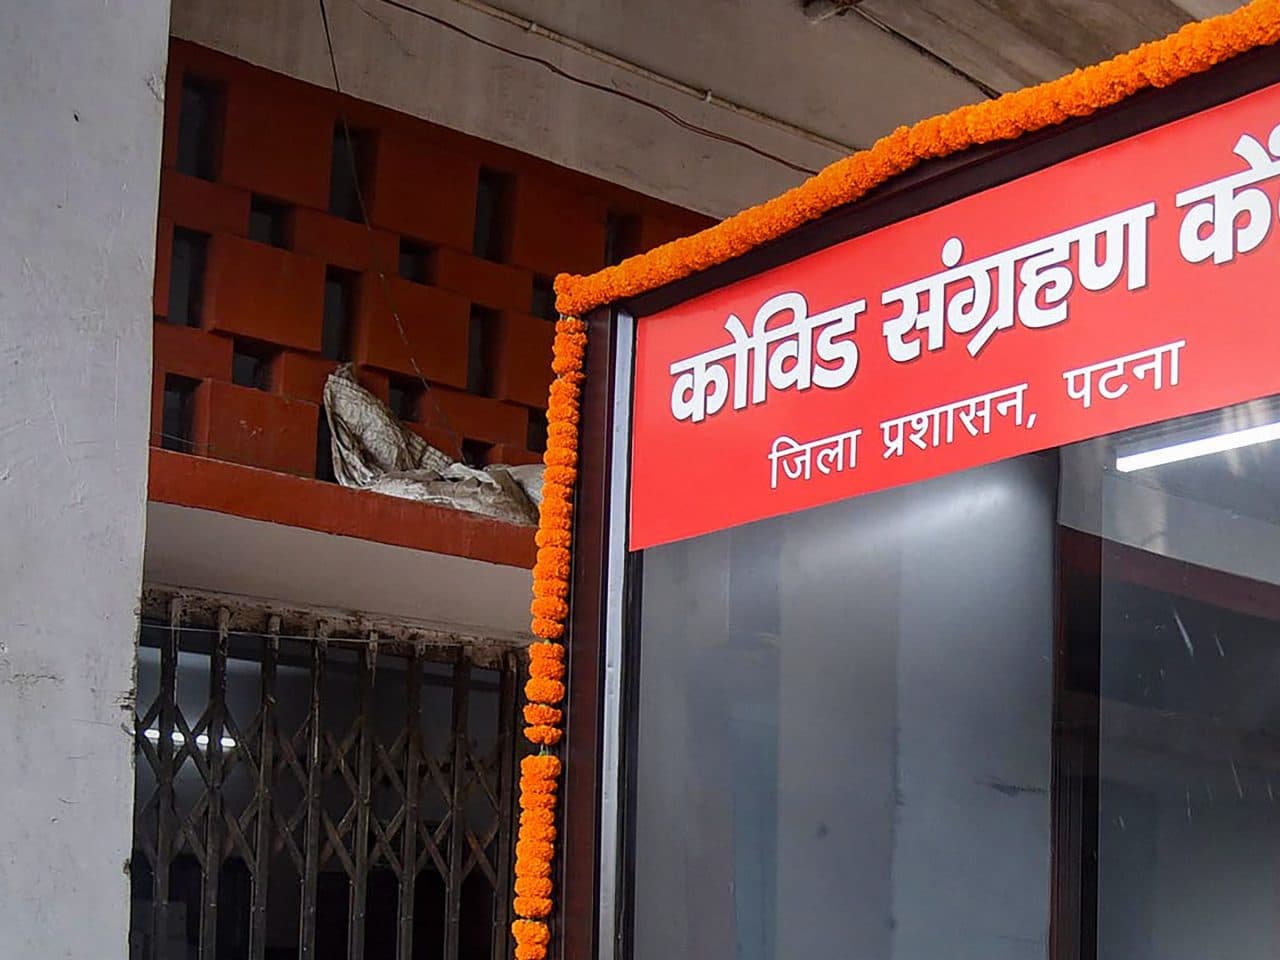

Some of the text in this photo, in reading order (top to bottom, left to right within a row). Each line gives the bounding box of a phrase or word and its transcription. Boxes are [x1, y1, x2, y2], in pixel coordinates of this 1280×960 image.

[670, 290, 866, 424] कोविड
[881, 201, 1157, 358] संग्रहण
[769, 340, 1187, 489] जिला प्रशासन, पटना
